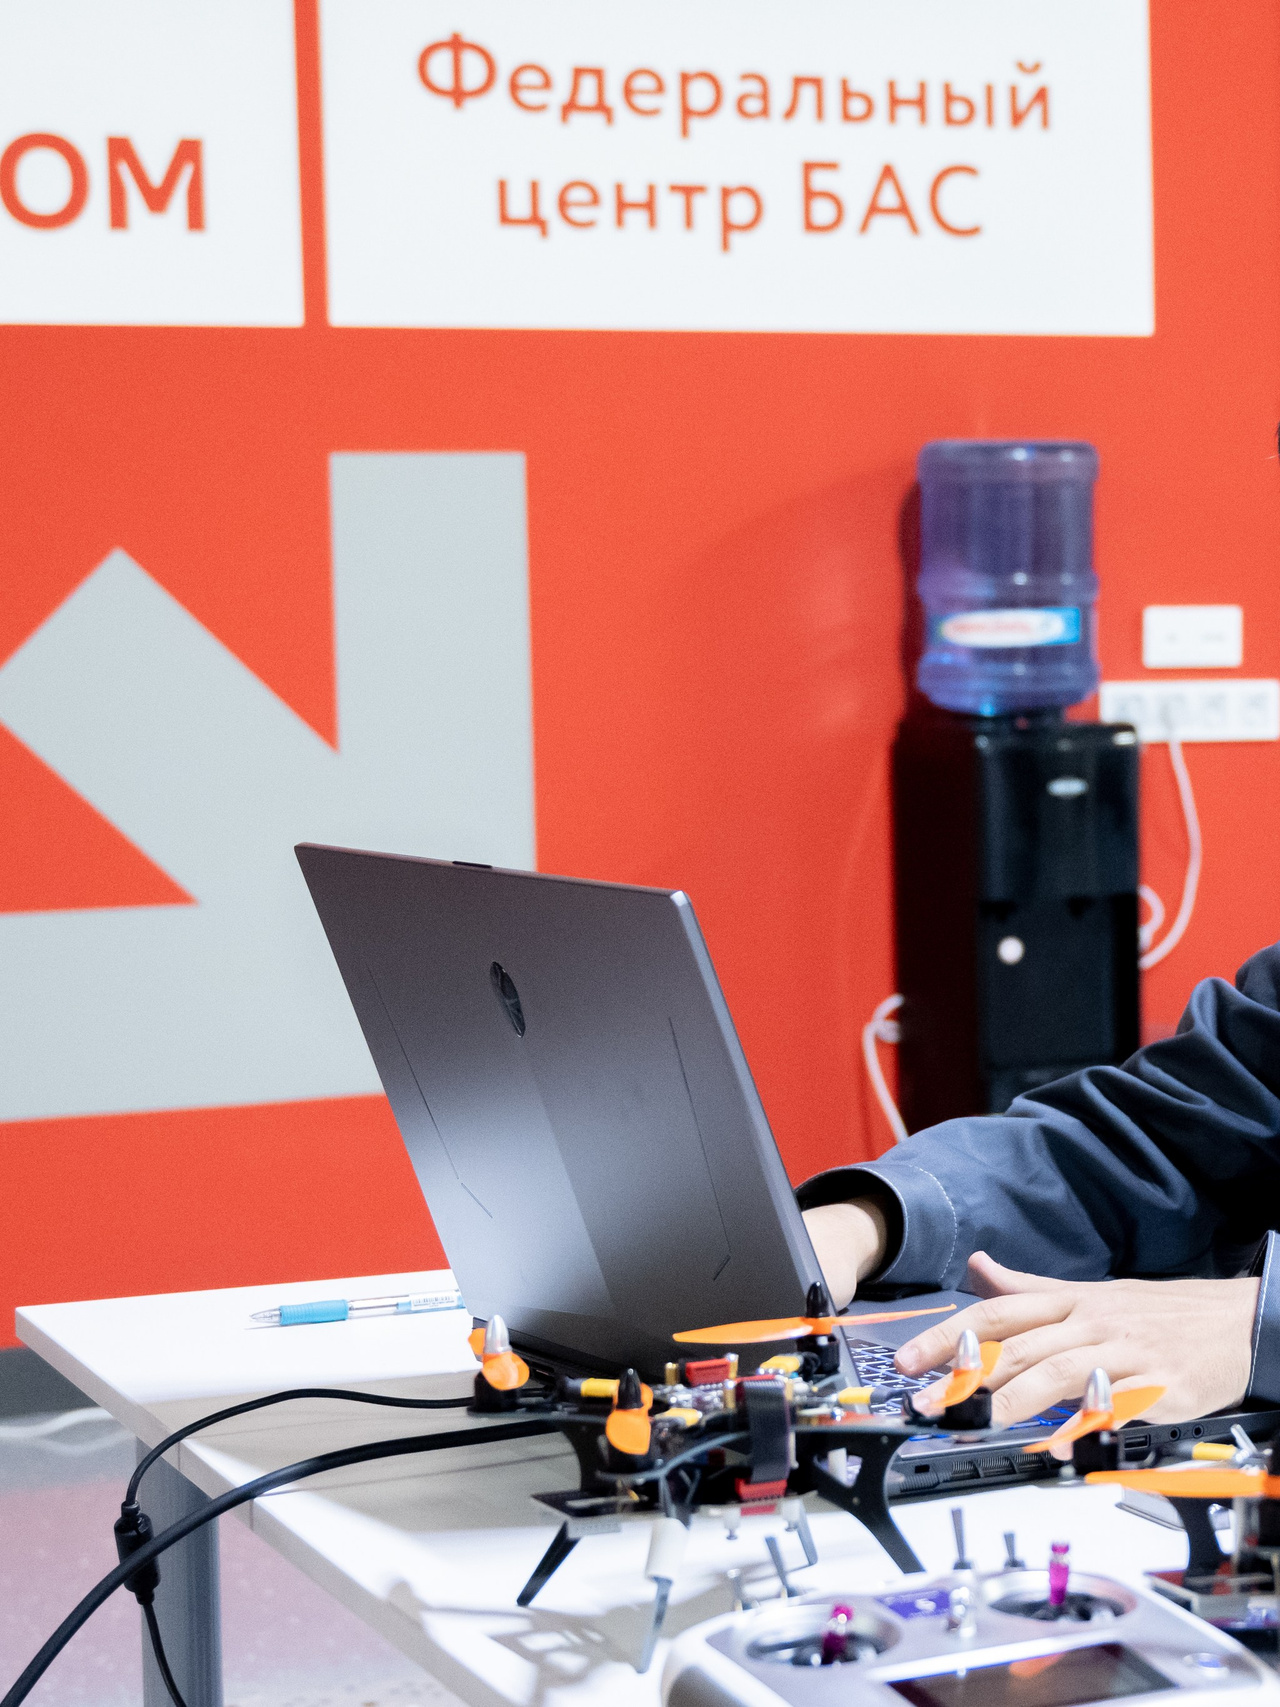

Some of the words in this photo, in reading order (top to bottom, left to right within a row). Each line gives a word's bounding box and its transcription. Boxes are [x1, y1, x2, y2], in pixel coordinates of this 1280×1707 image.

[417, 32, 1050, 140] Федеральный
[498, 179, 764, 253] центр
[801, 161, 982, 237] БАС
